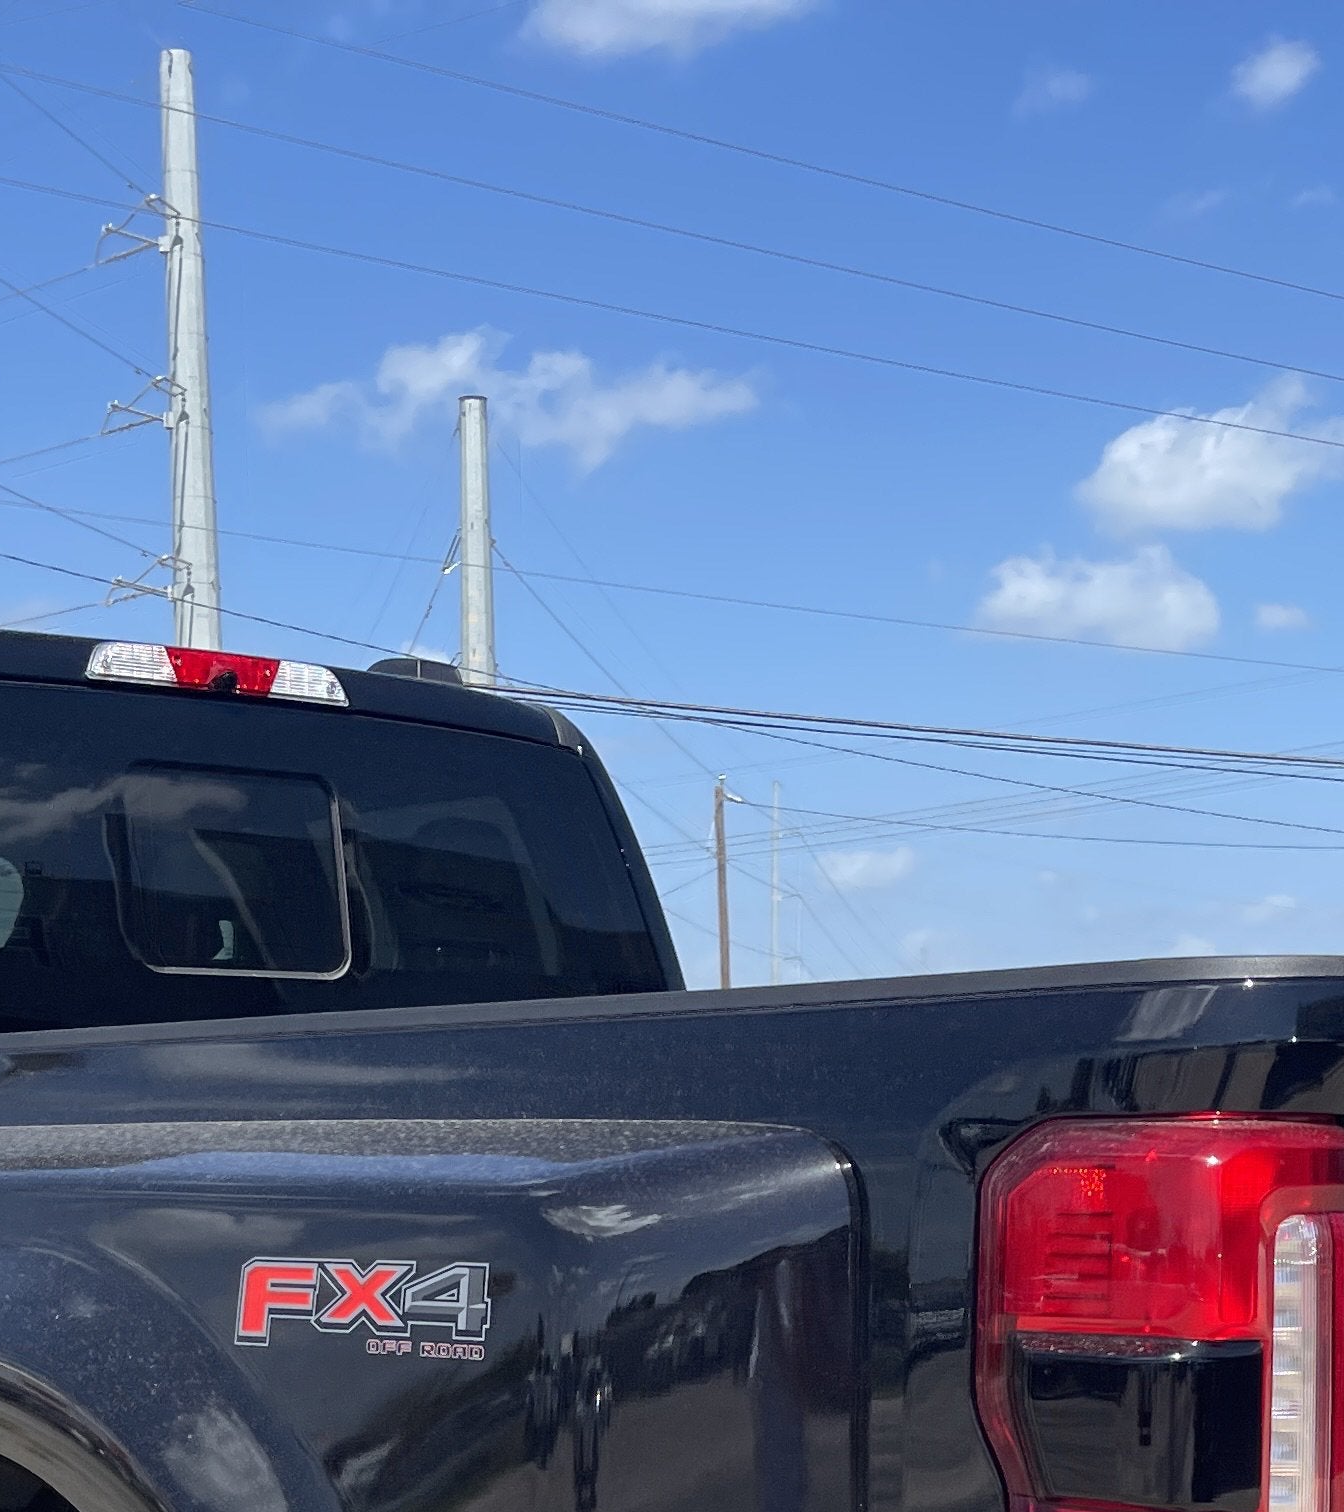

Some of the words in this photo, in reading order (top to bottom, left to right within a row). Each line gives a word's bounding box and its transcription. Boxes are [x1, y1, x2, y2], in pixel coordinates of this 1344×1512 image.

[236, 1257, 490, 1344] FX4
[366, 1339, 412, 1356] OFF
[419, 1342, 485, 1361] ROAD
